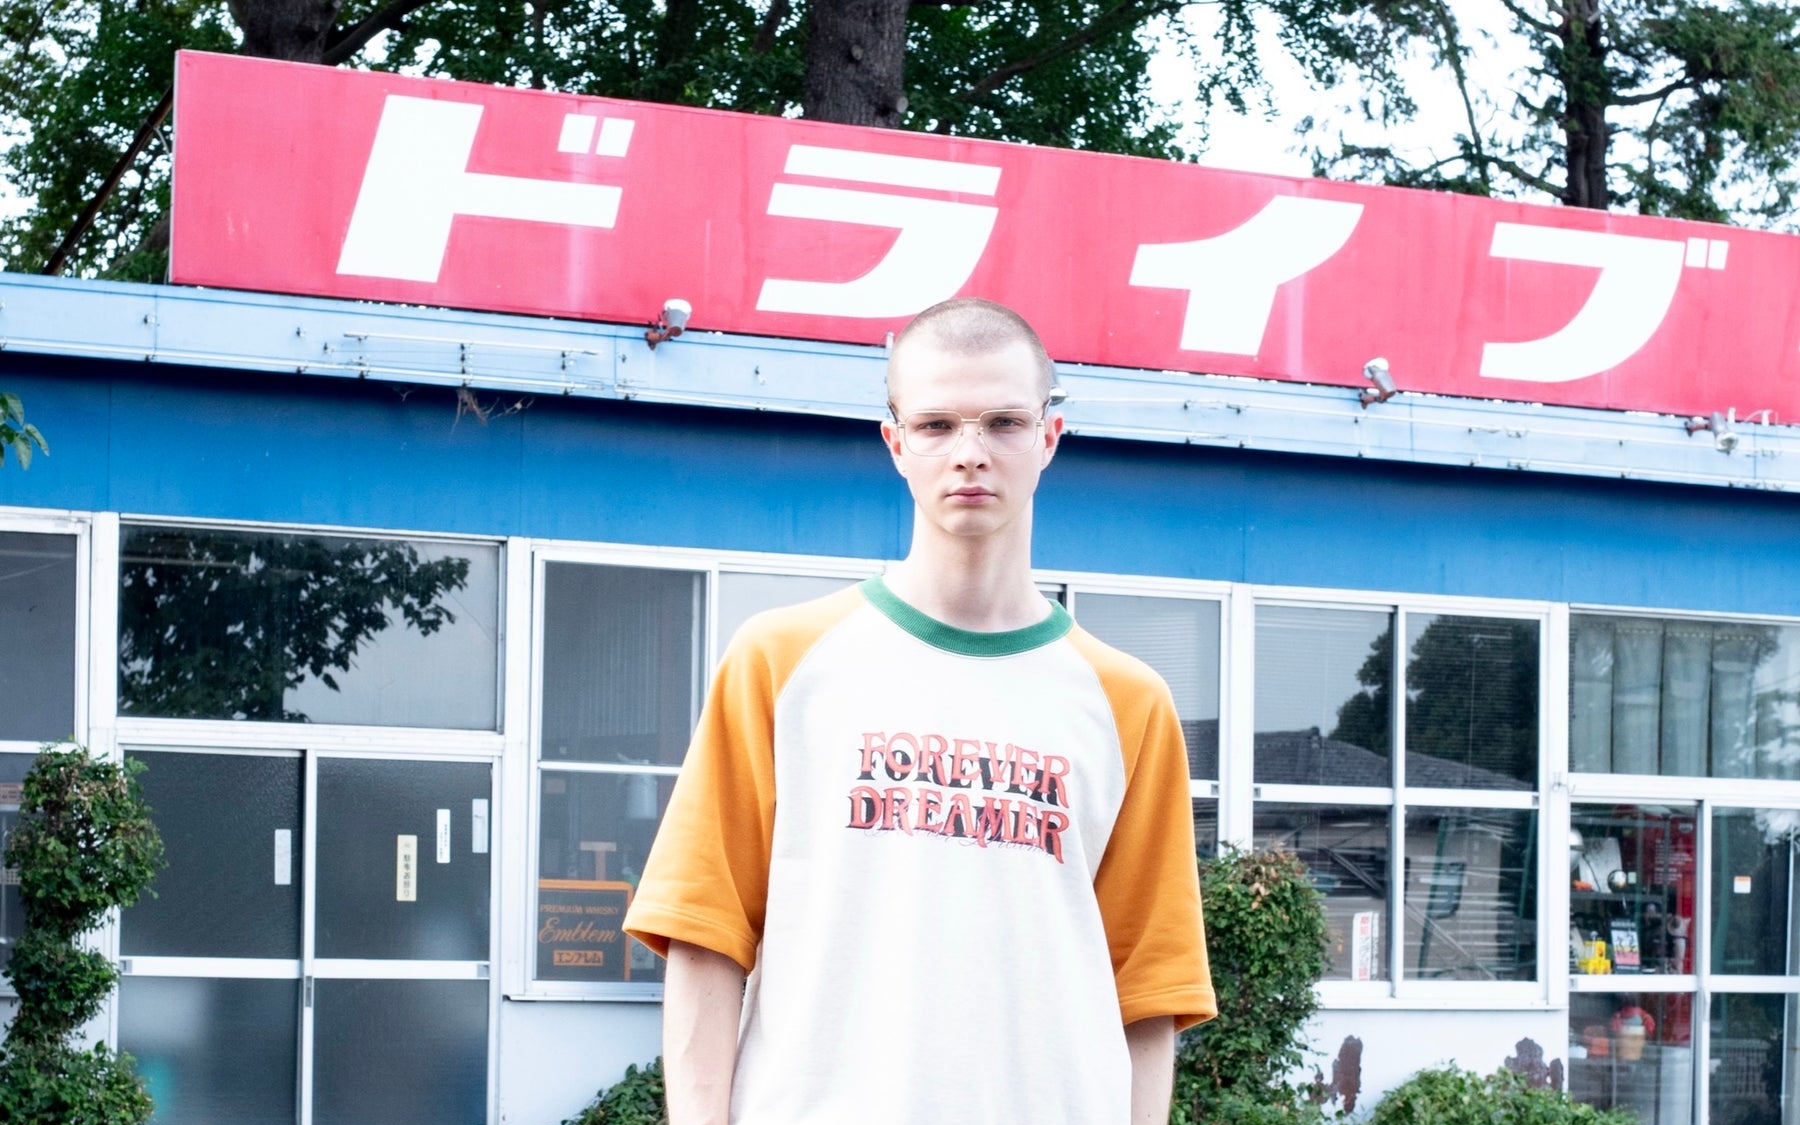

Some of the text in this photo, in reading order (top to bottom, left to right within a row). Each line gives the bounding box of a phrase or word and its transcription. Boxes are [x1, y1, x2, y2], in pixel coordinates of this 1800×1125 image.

[335, 93, 1730, 383] ドライブ
[856, 731, 1071, 809] FOREVER
[846, 785, 1071, 865] DREAMER
[538, 917, 619, 943] Emblem
[540, 904, 618, 915] PREMIUM WHISKY
